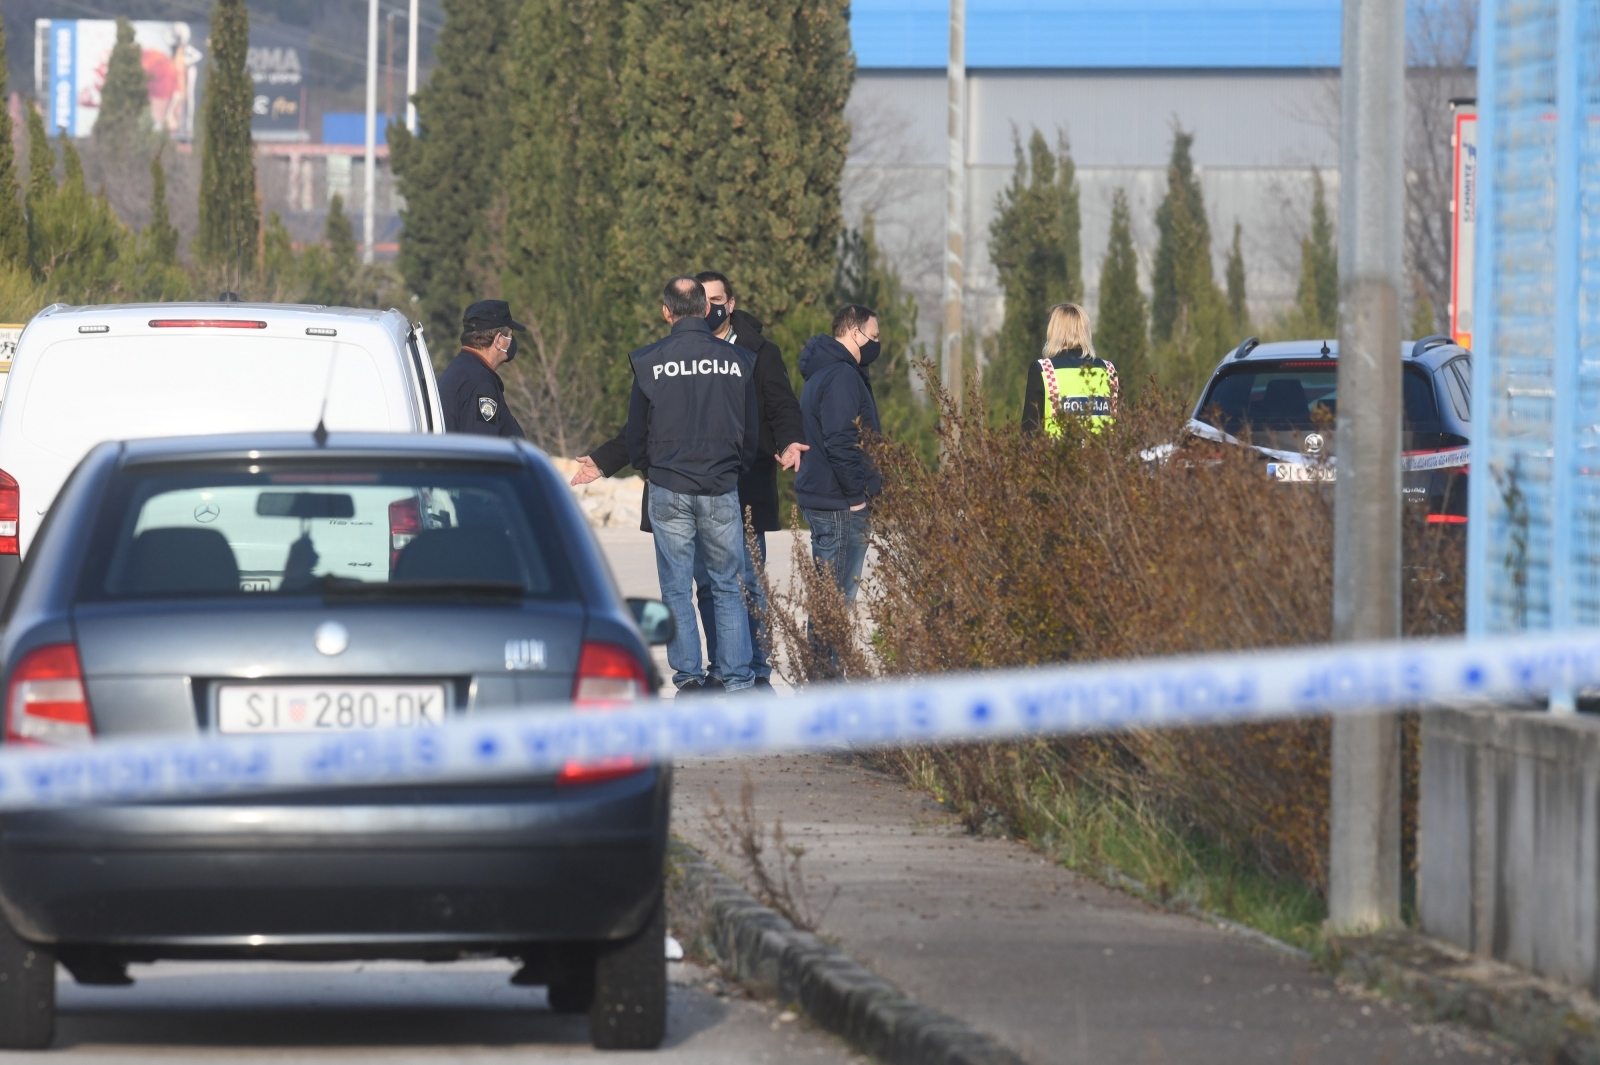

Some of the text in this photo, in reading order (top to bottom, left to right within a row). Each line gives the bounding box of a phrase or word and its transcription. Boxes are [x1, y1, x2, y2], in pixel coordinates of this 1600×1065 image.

[244, 46, 302, 73] RMA
[652, 359, 742, 380] POLICIJA
[245, 692, 279, 728] SI
